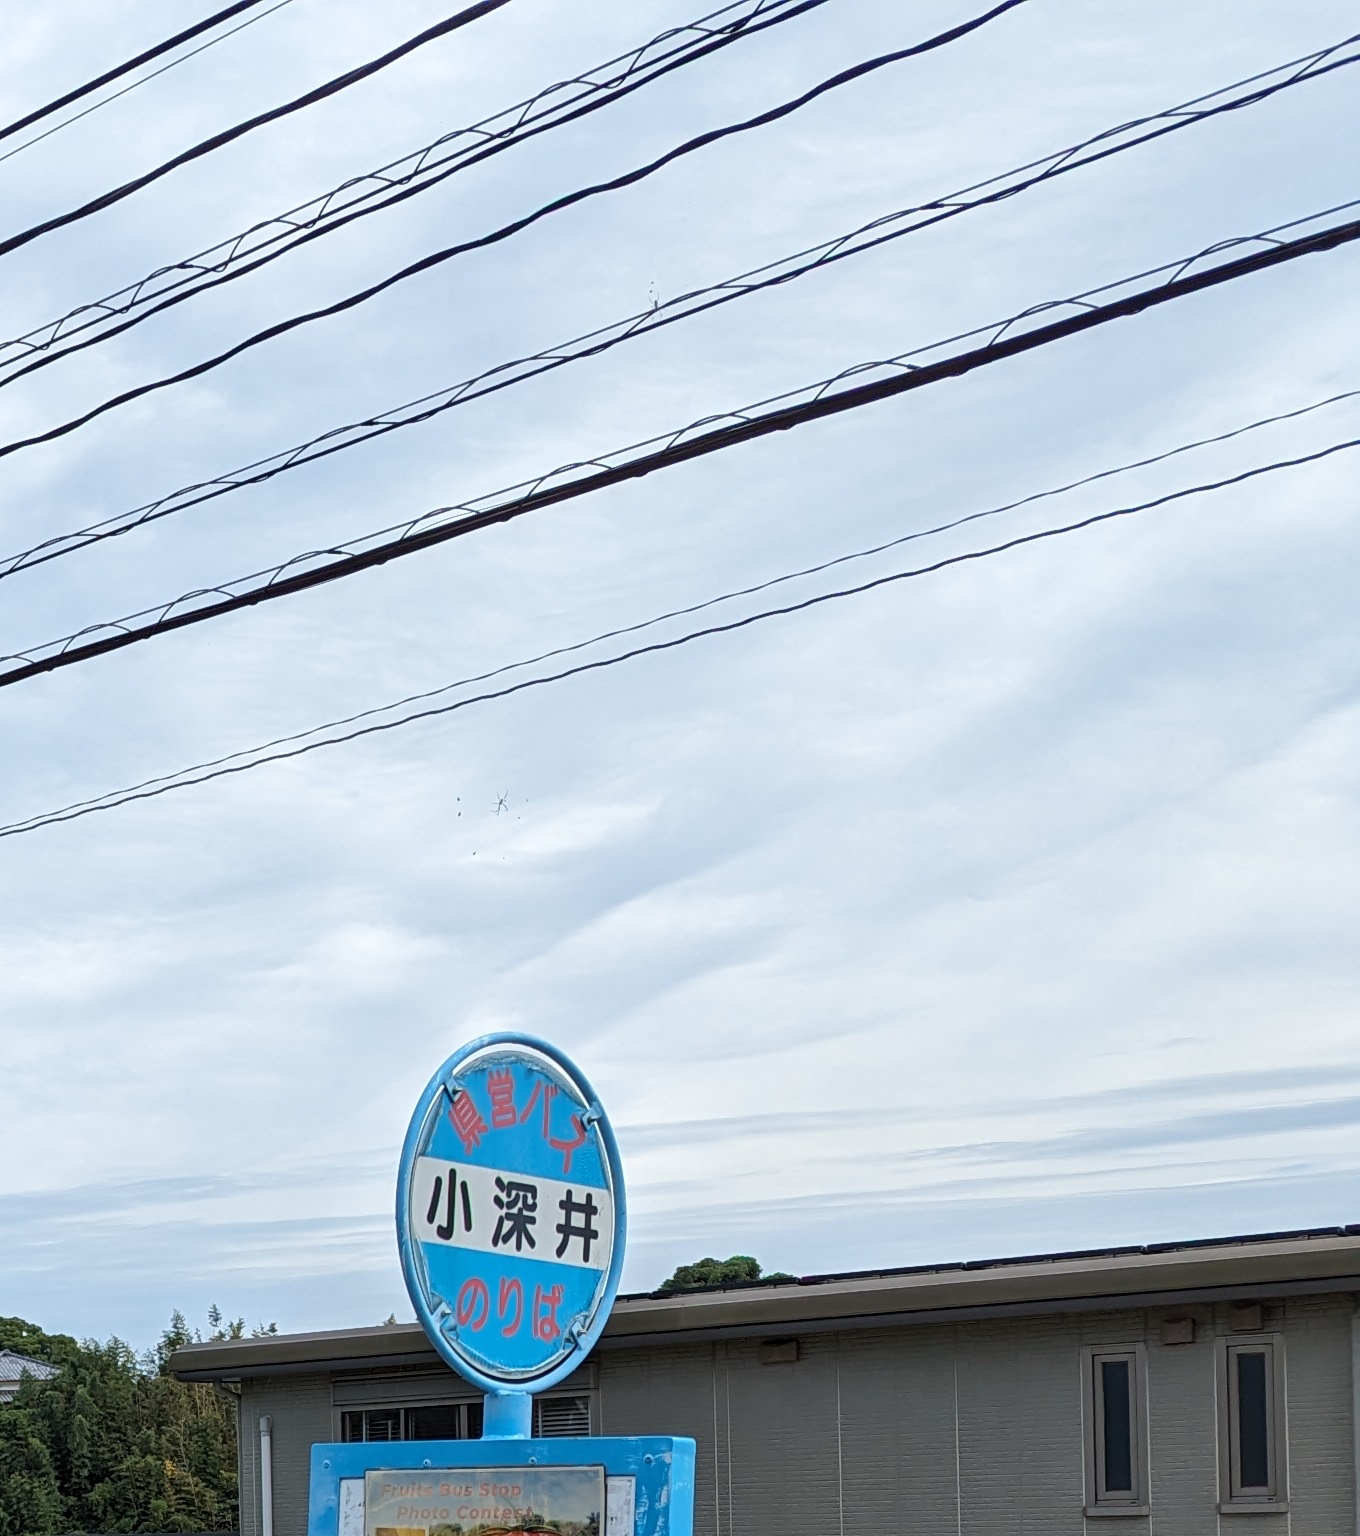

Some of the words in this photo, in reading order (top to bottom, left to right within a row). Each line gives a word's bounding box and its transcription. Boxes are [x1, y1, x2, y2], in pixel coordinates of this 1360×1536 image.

[448, 1066, 588, 1173] 県営バス
[425, 1167, 600, 1264] 小深井
[455, 1276, 566, 1343] のりば
[381, 1482, 433, 1497] Fruits
[439, 1482, 473, 1497] Bus
[479, 1482, 522, 1499] Stop
[396, 1505, 450, 1520] Photo
[456, 1505, 534, 1522] Contest
